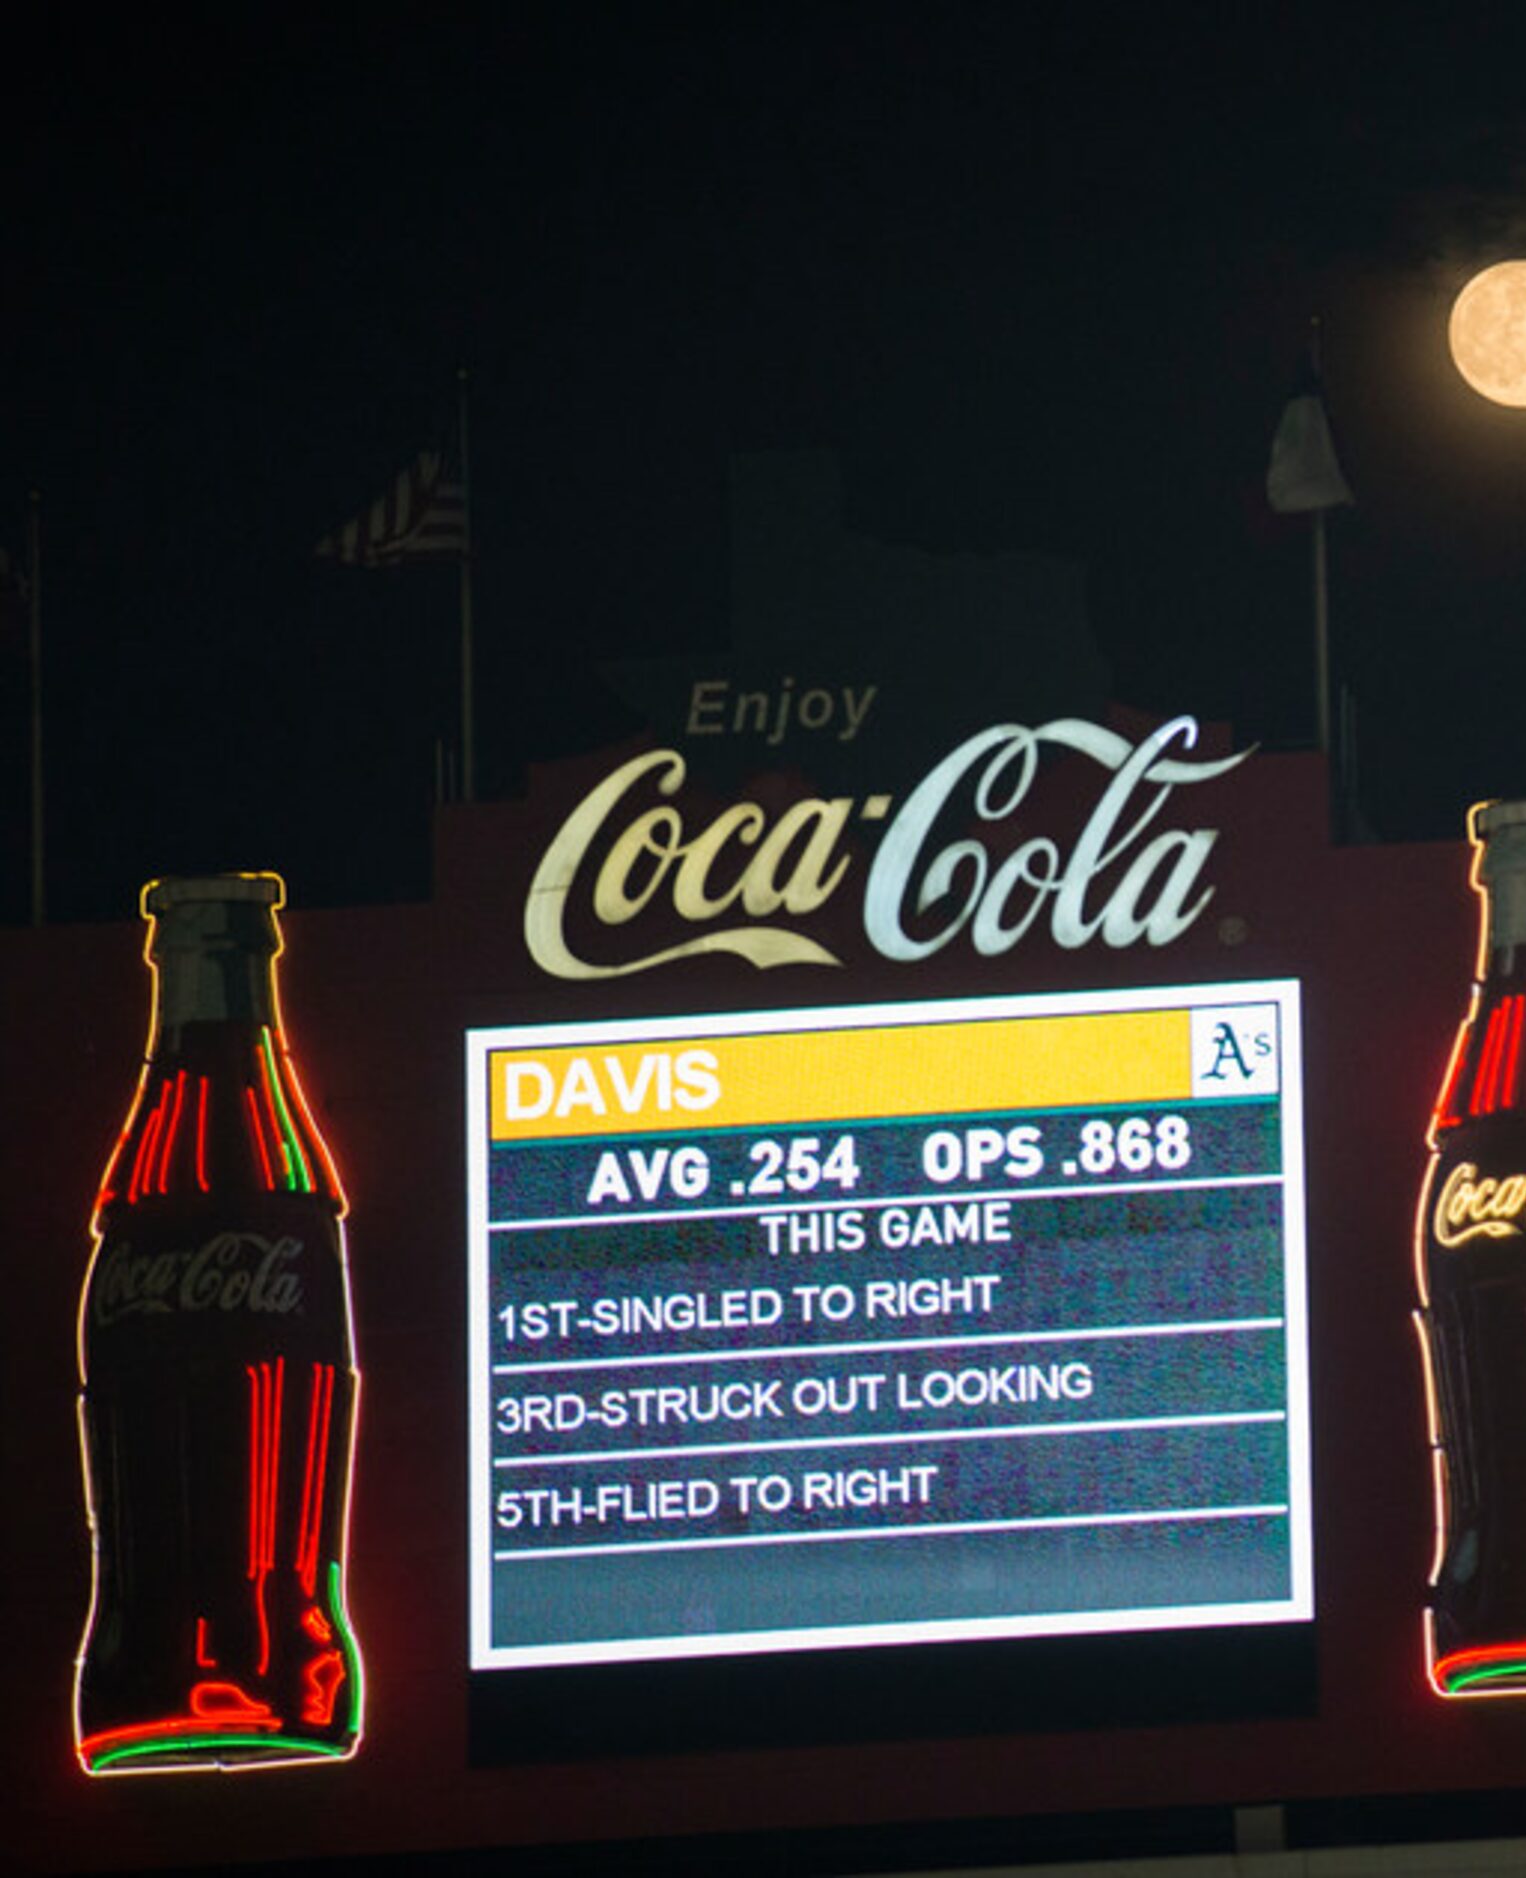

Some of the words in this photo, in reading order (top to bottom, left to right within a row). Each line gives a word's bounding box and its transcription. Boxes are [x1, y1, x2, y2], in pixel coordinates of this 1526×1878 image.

[685, 677, 878, 746] Enjoy
[523, 714, 1261, 980] Coca-Cola
[505, 1049, 721, 1121] DAVIS
[587, 1147, 710, 1204] AVG
[730, 1135, 860, 1196] .254
[922, 1126, 1043, 1183] OPS
[1062, 1115, 1192, 1176] .868
[759, 1210, 866, 1255] THIS
[880, 1202, 1012, 1248] GAME
[497, 1288, 783, 1341] 1ST-SINGLED
[793, 1285, 855, 1322] TO
[866, 1275, 1001, 1318] RIGHT
[497, 1381, 785, 1433] 3RD-STRUCK
[793, 1374, 886, 1415] OUT
[897, 1362, 1093, 1410] LOOKING
[497, 1480, 719, 1528] 5TH-FLIED
[730, 1475, 792, 1514] TO
[803, 1466, 939, 1510] RIGHT
